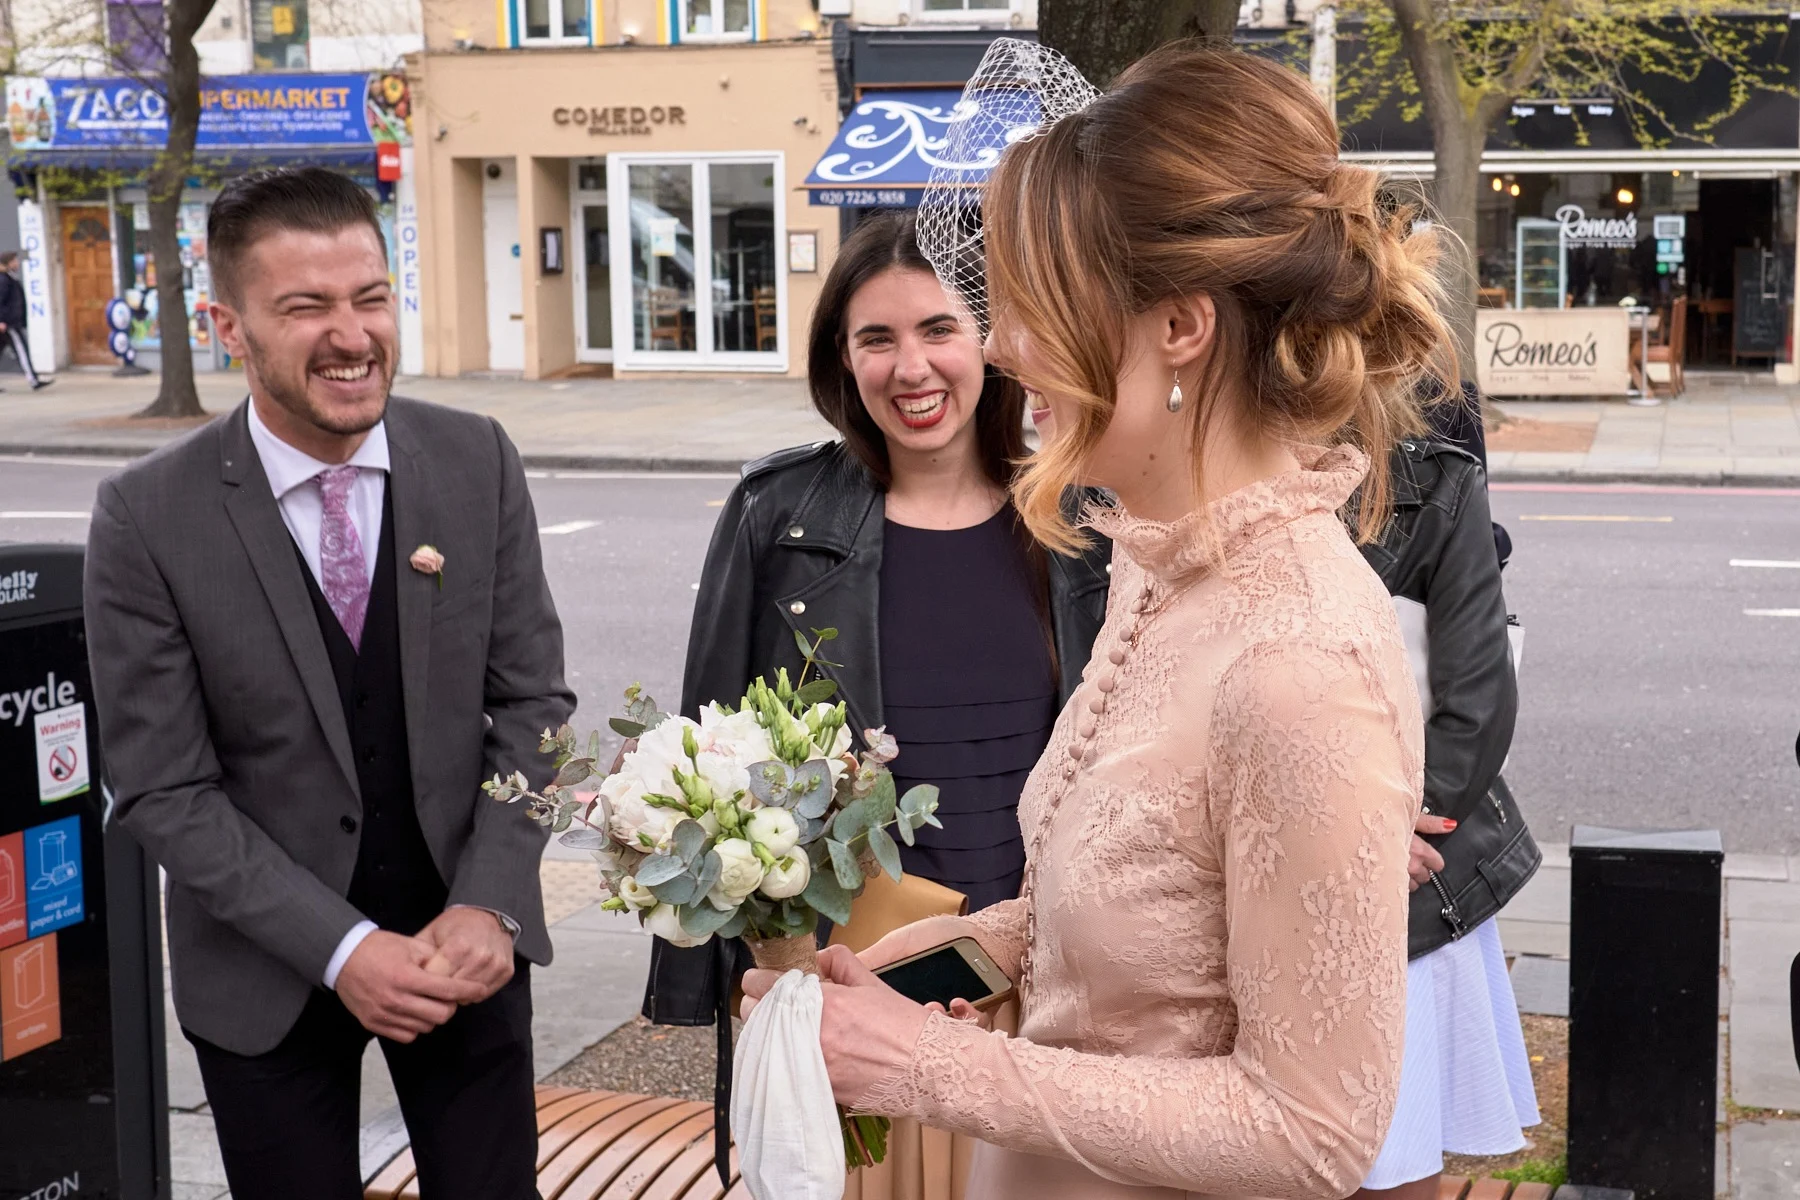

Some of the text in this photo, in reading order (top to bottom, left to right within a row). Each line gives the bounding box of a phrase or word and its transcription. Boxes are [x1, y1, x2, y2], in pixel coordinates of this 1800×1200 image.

[61, 87, 350, 129] ZACO PERMARKET
[552, 106, 687, 126] COMEDOR
[1555, 204, 1637, 239] Romeo's
[26, 235, 44, 317] OPEN
[402, 226, 417, 312] OPEN
[1485, 321, 1597, 368] Romeo's
[0, 569, 39, 590] elly
[40, 718, 82, 736] Warning
[30, 914, 54, 932] paper
